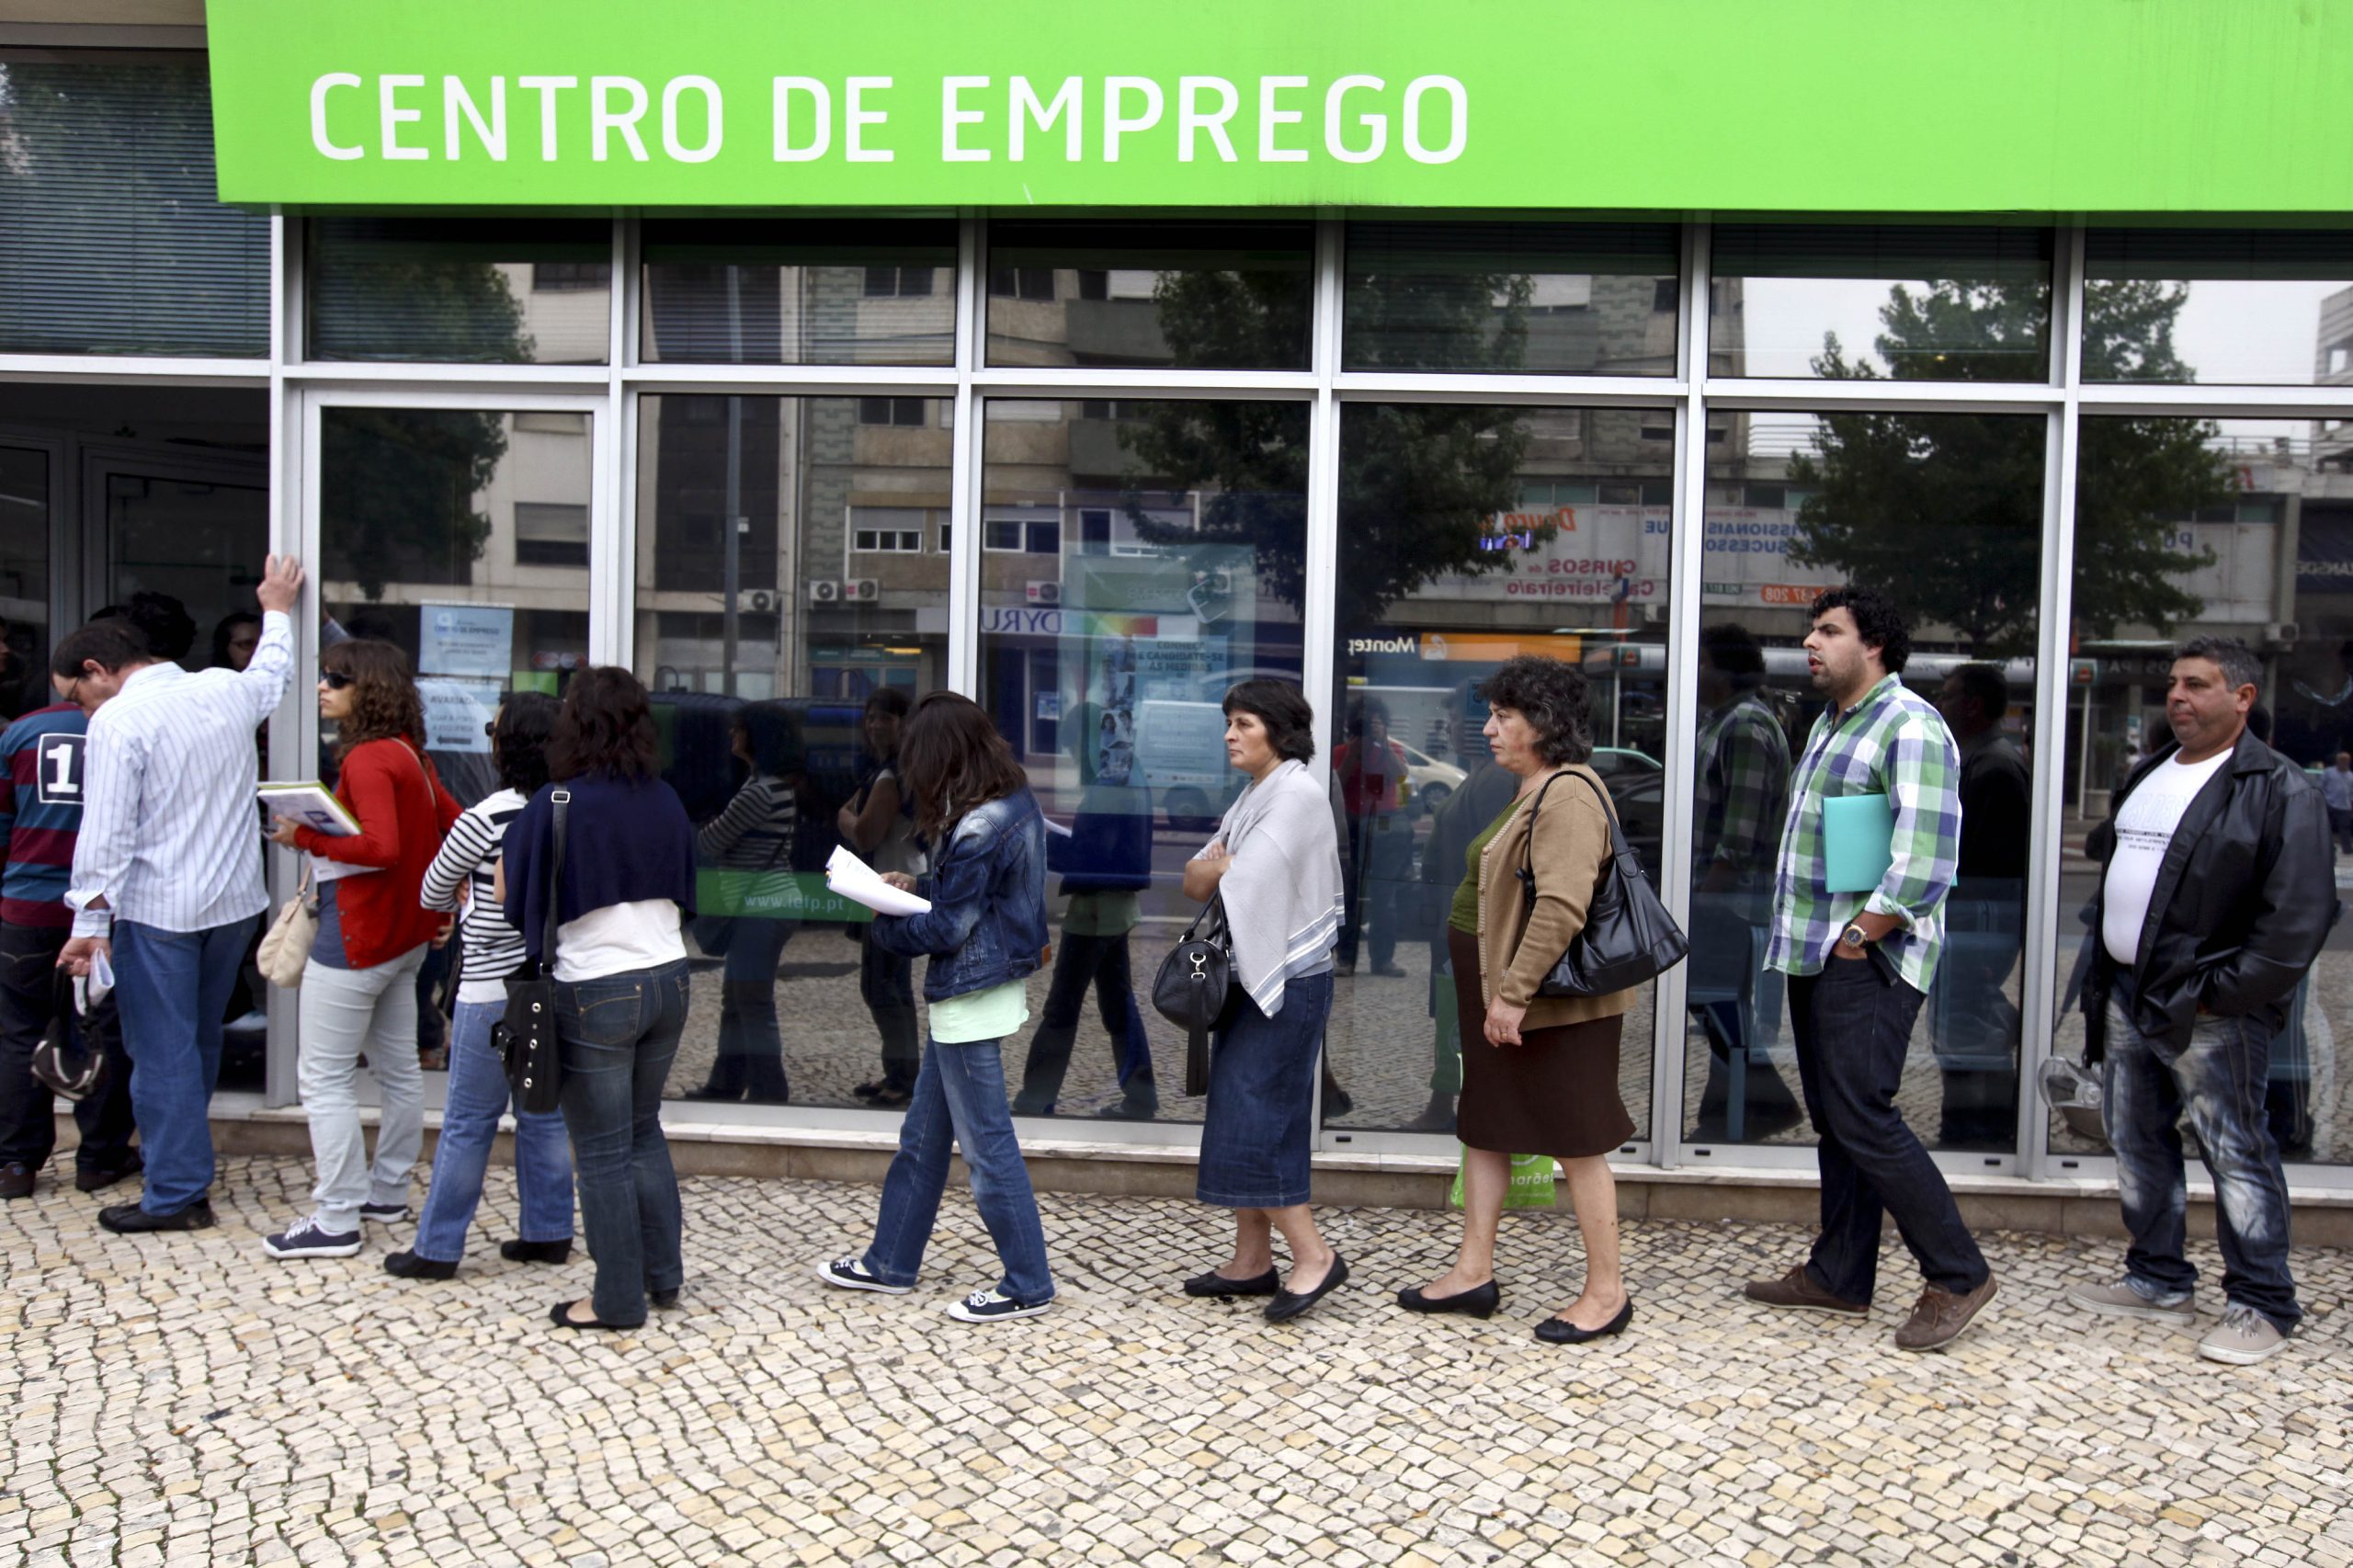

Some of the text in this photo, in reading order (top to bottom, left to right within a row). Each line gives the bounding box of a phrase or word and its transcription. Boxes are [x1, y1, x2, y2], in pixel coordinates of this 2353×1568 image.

[310, 72, 1468, 165] CENTRO DE EMPREGO
[46, 744, 79, 793] 1
[745, 894, 845, 912] www.iefp.pt
